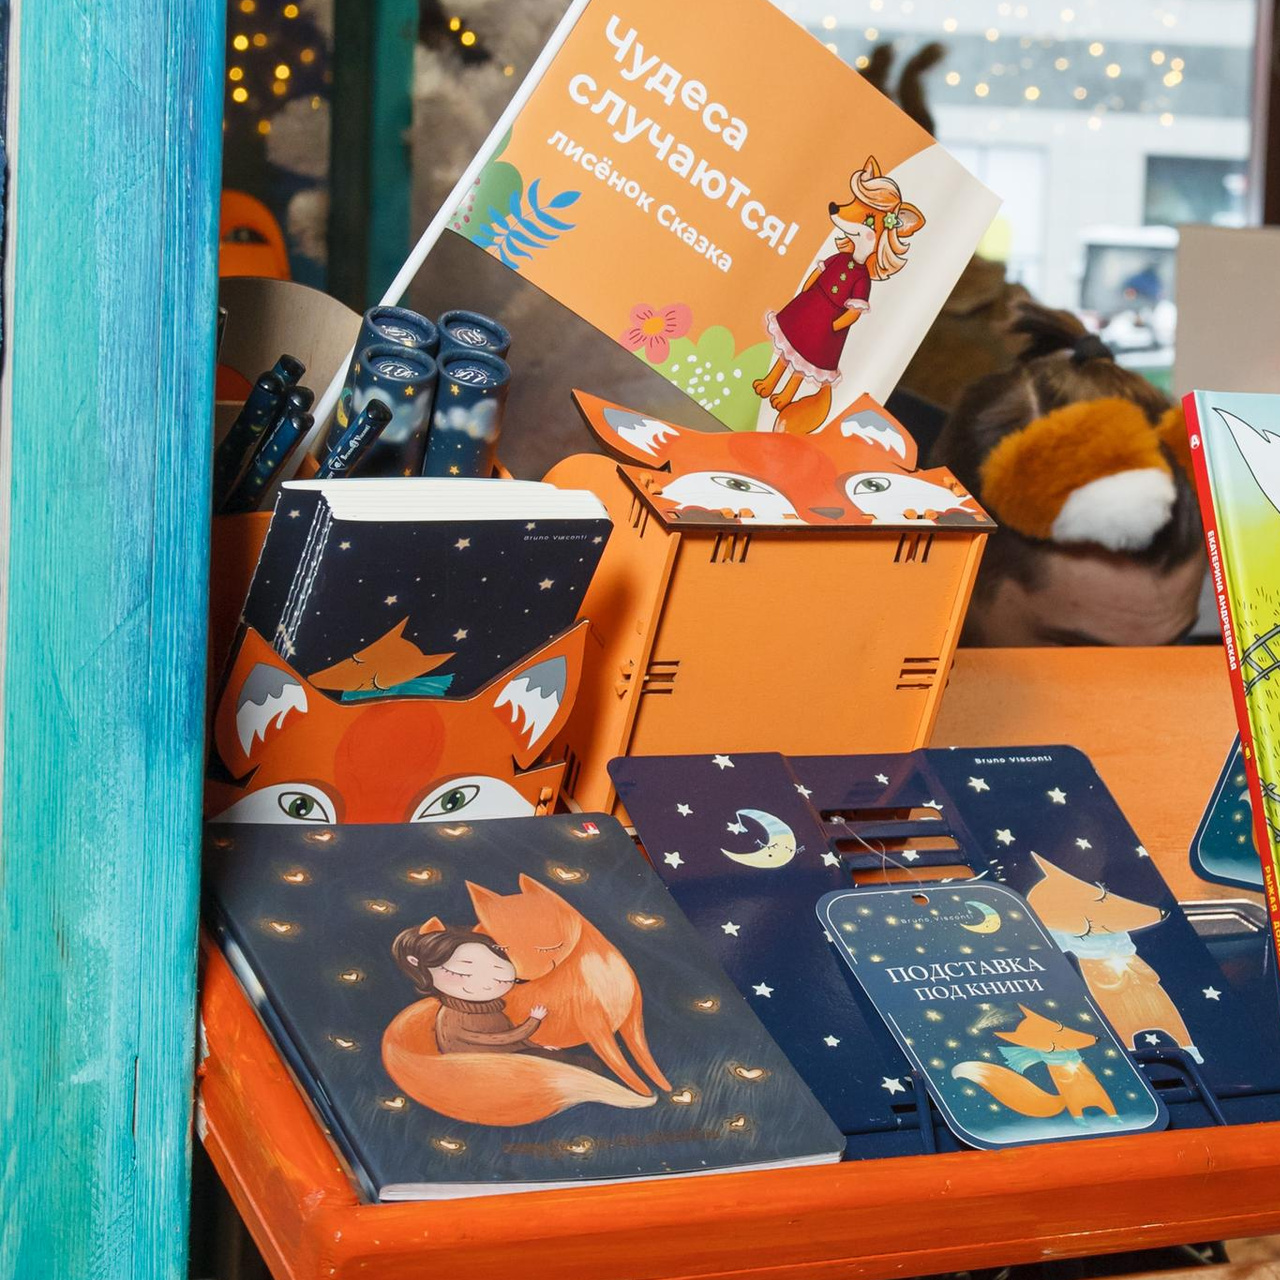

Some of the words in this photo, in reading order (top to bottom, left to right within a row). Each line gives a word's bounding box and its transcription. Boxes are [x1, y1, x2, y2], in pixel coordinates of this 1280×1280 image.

[605, 14, 749, 152] Чудеса
[547, 129, 655, 212] лисёнок
[657, 203, 734, 273] Сказка
[568, 72, 802, 256] случаются!
[1207, 530, 1224, 592] ЕКАТЕРИНА
[1218, 594, 1238, 671] АНДРЕЕВСКАЯ
[1009, 755, 1053, 763] Visconti
[1264, 866, 1278, 913] РЫЖАЯ
[885, 956, 1047, 983] ПОДСТАВКА
[913, 984, 967, 1001] ПОД
[965, 978, 1044, 996] КНИГИ
